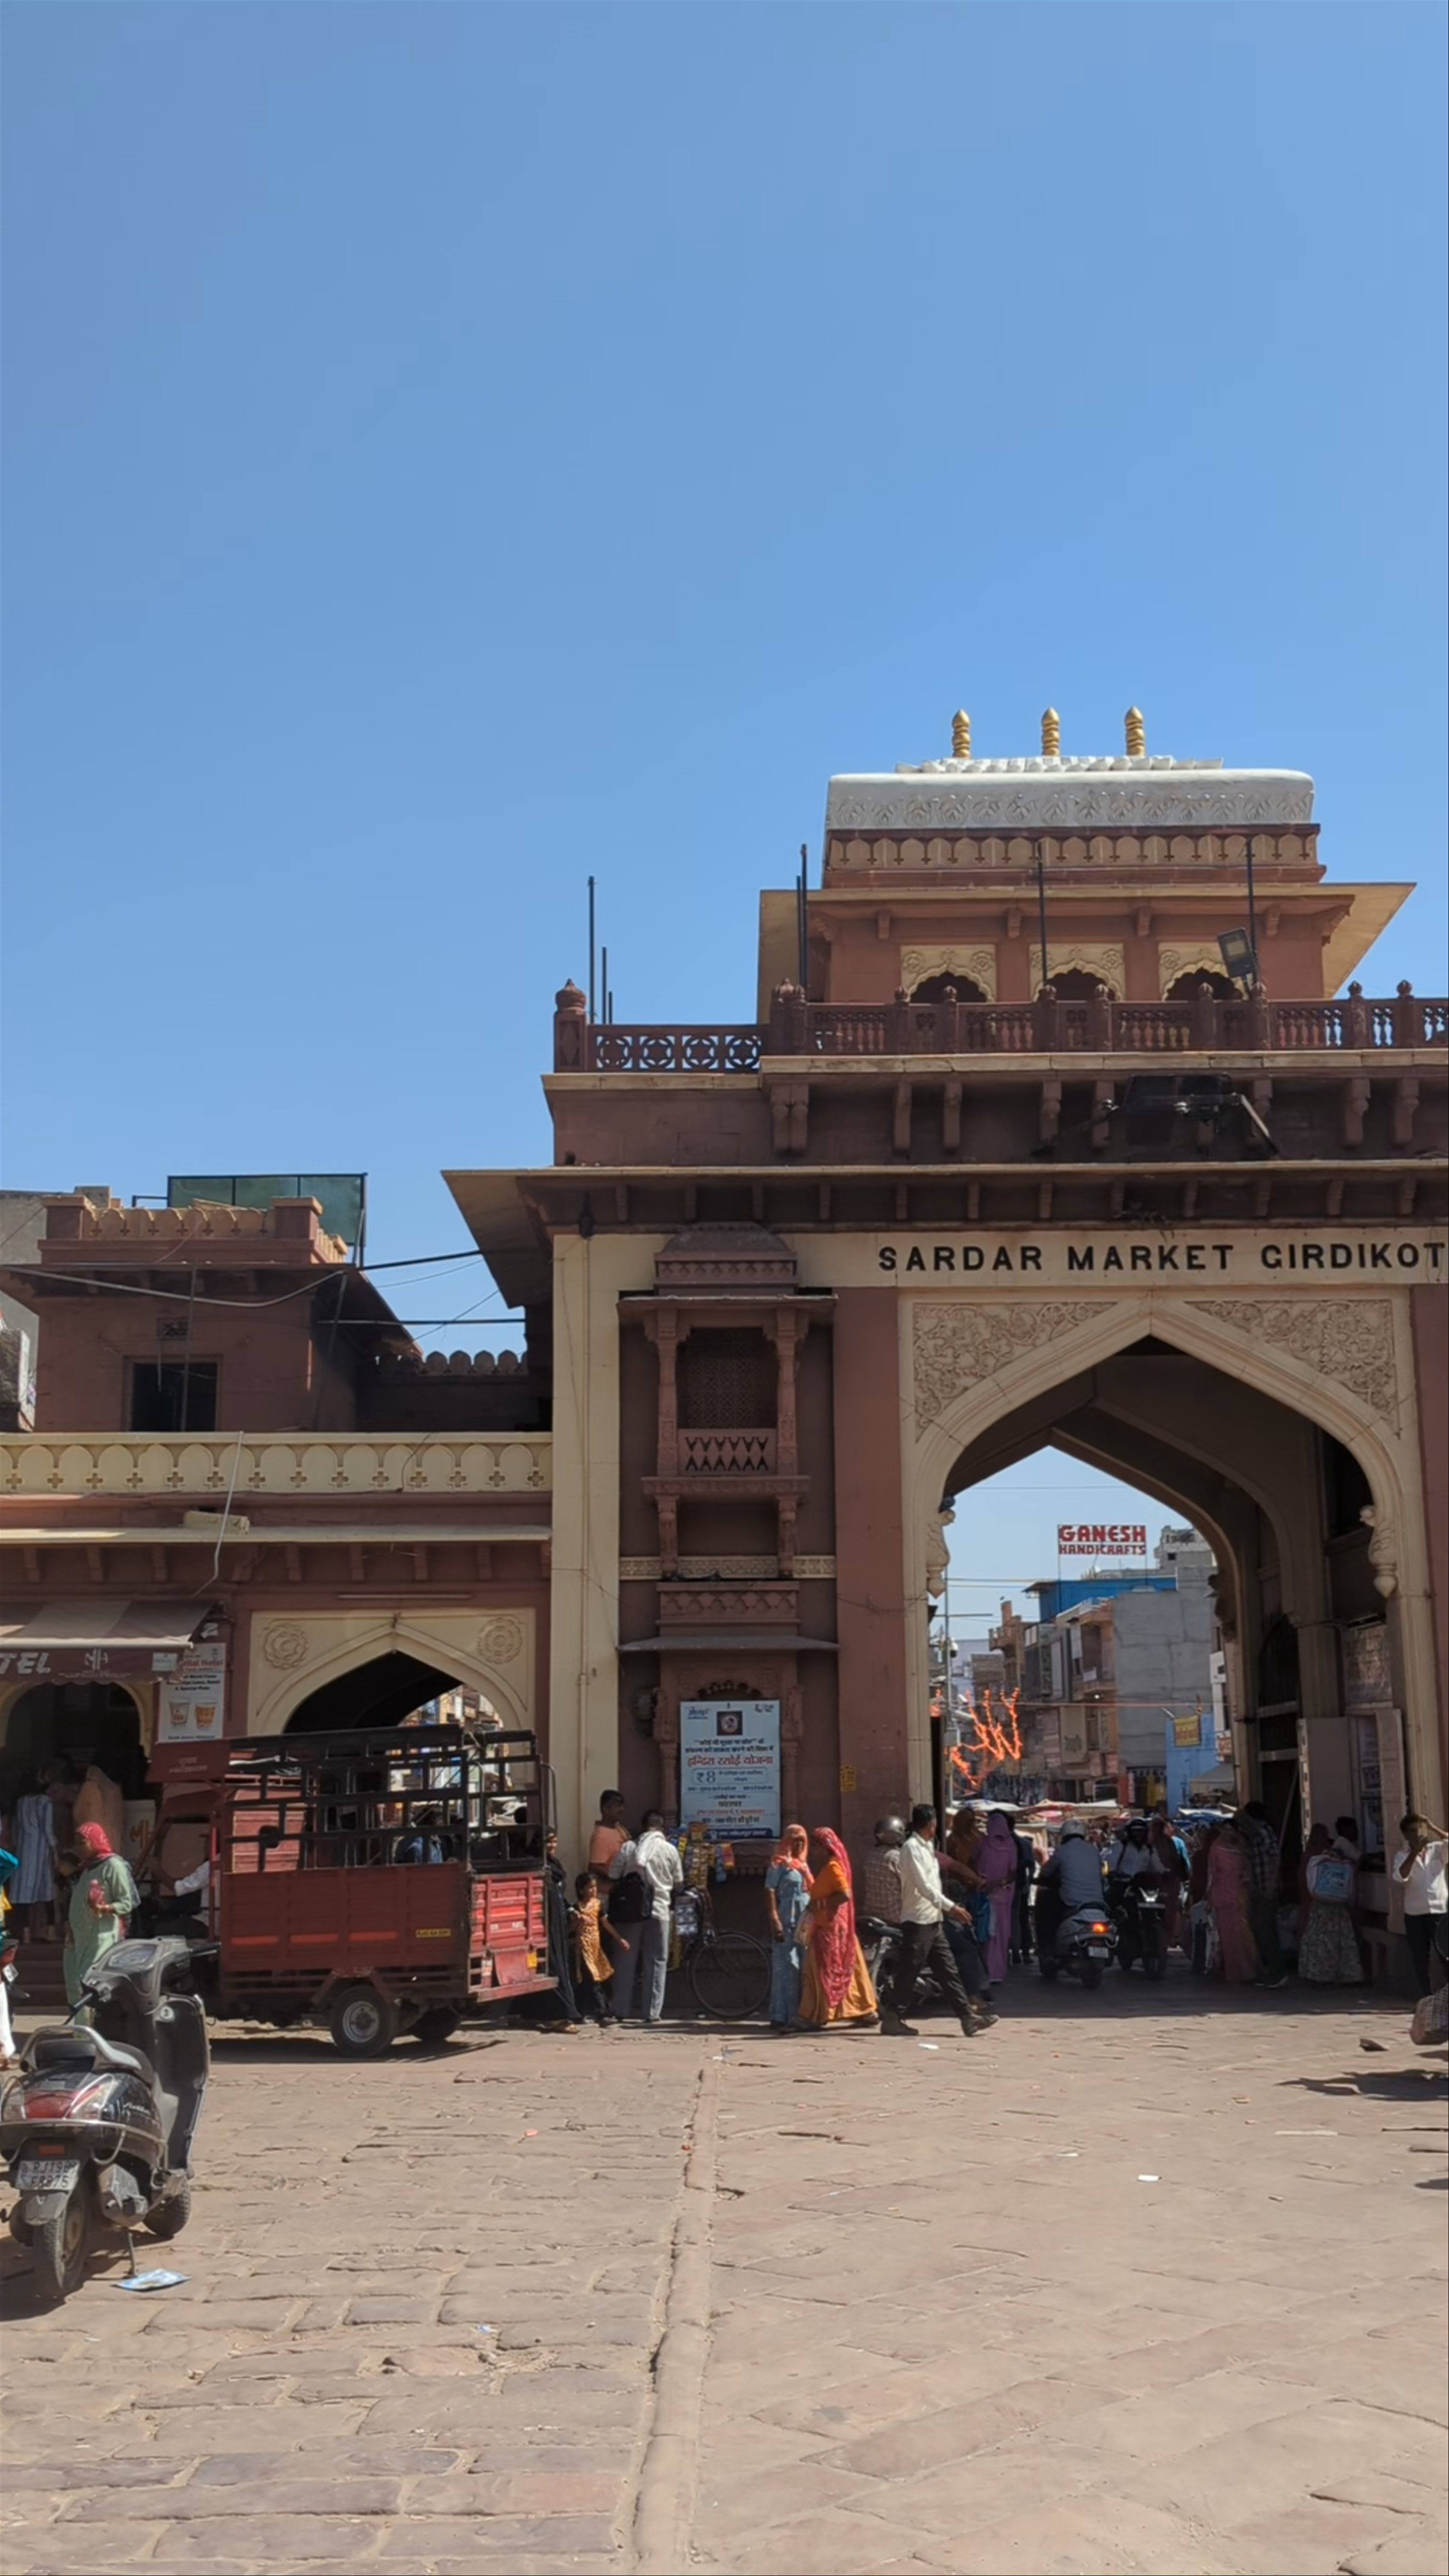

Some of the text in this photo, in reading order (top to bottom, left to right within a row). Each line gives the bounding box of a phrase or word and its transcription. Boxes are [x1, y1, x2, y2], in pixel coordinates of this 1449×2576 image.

[878, 1243, 1445, 1271] SARDAR MARKET GIRDIKOT
[1059, 1525, 1146, 1542] GANESH
[1059, 1545, 1146, 1555] HANDICRAFTS
[0, 1652, 51, 1674] TEL
